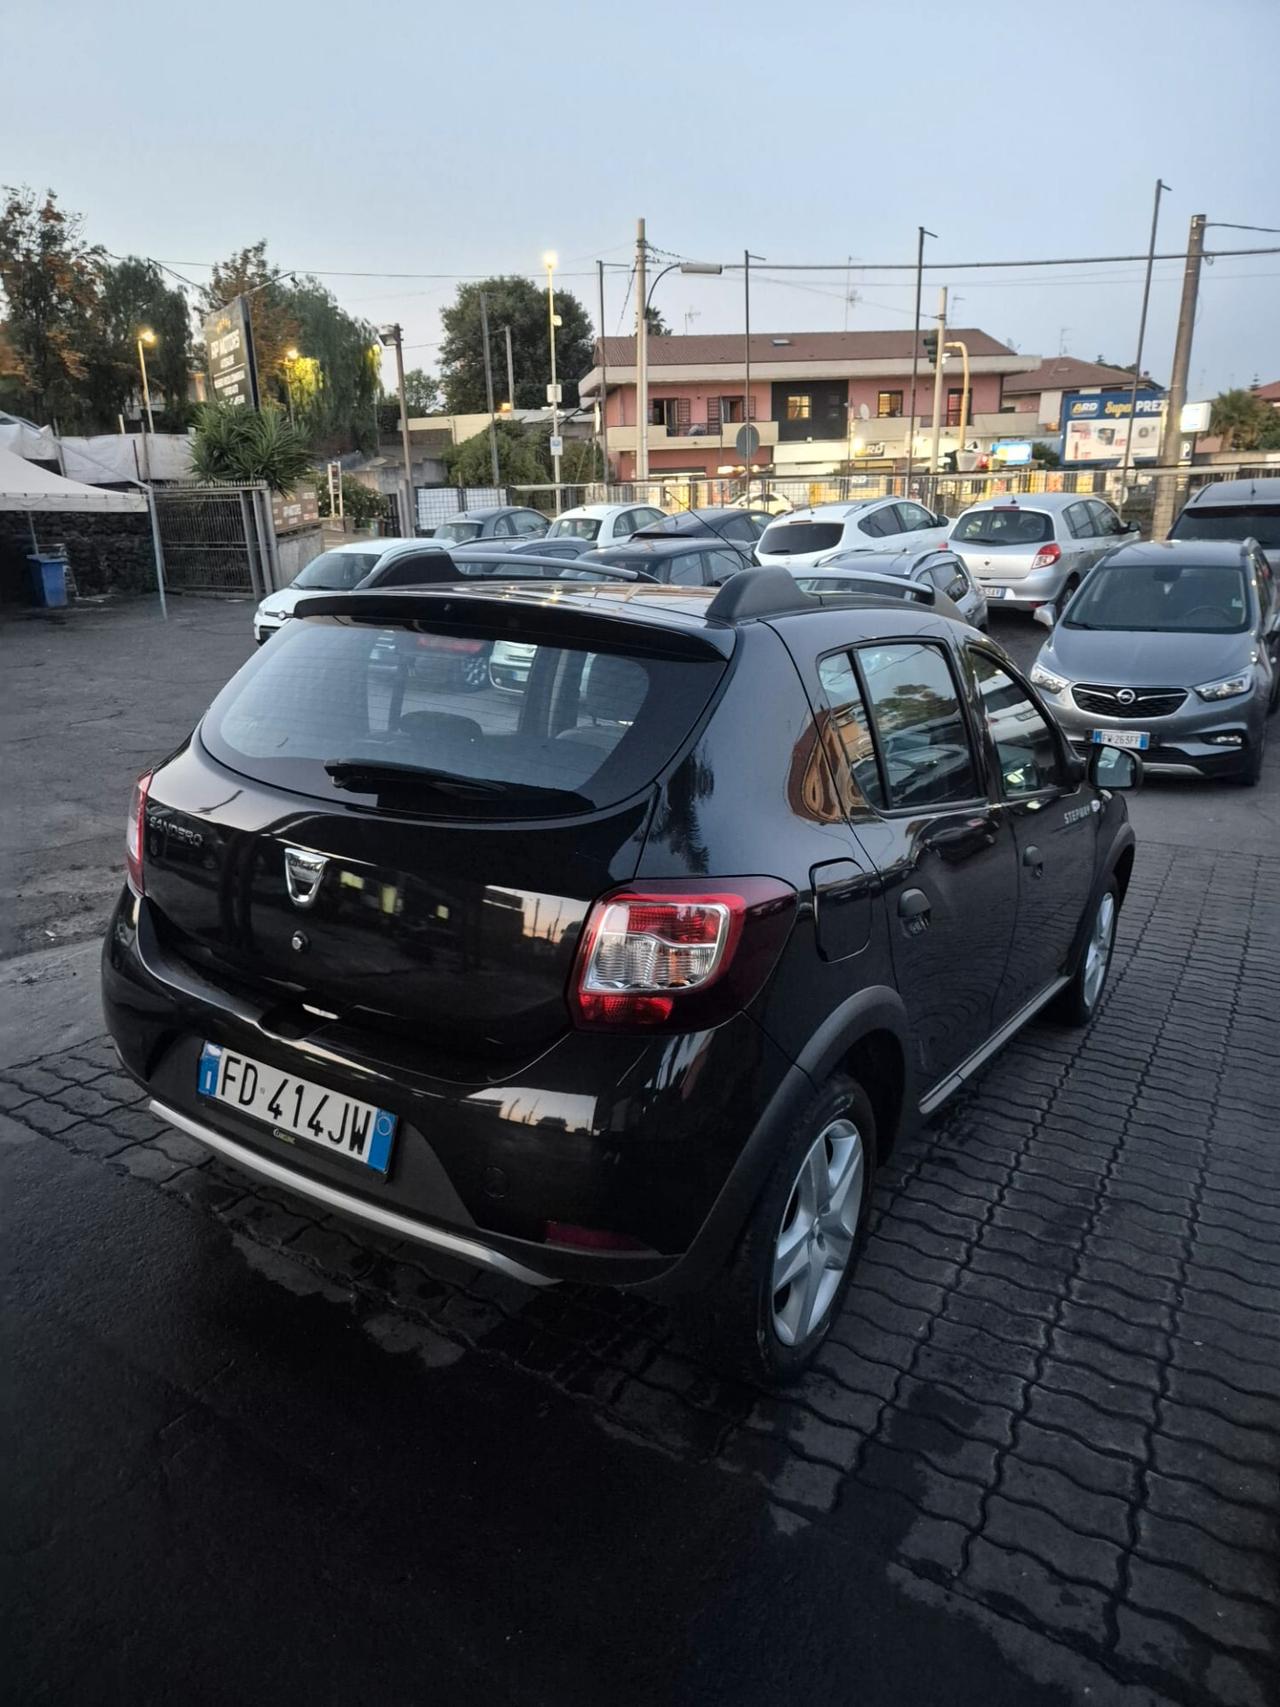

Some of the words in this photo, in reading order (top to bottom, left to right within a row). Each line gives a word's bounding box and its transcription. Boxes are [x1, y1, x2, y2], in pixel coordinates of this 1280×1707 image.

[1072, 402, 1098, 413] ARD
[221, 1055, 258, 1106] FD
[267, 1078, 372, 1155] 414JW
